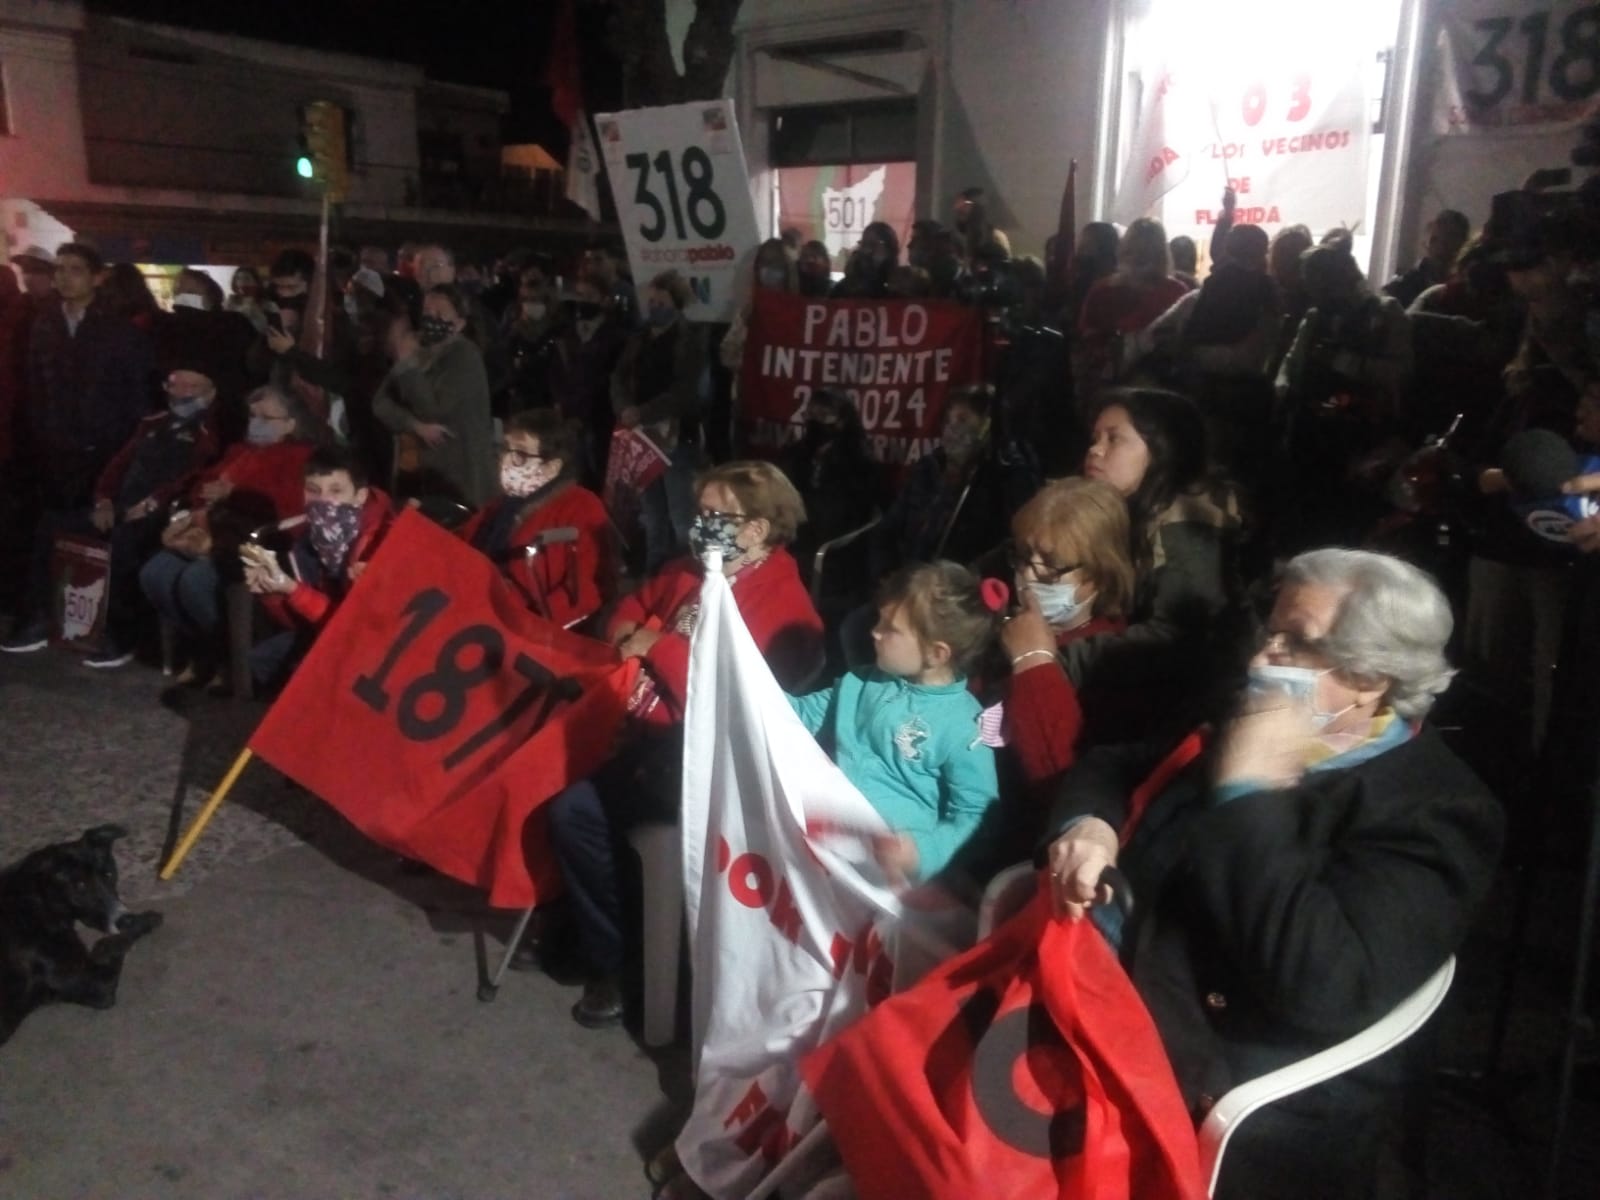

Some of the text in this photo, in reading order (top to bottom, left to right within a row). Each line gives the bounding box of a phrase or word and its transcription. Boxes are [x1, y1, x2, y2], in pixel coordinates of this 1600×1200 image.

[1470, 4, 1600, 107] 318
[1262, 129, 1350, 157] VECINOS
[626, 145, 726, 243] 318
[828, 196, 867, 230] 501
[1195, 205, 1281, 226] FLRIDA
[804, 304, 928, 347] PABLO
[761, 345, 953, 384] INTENDENTE
